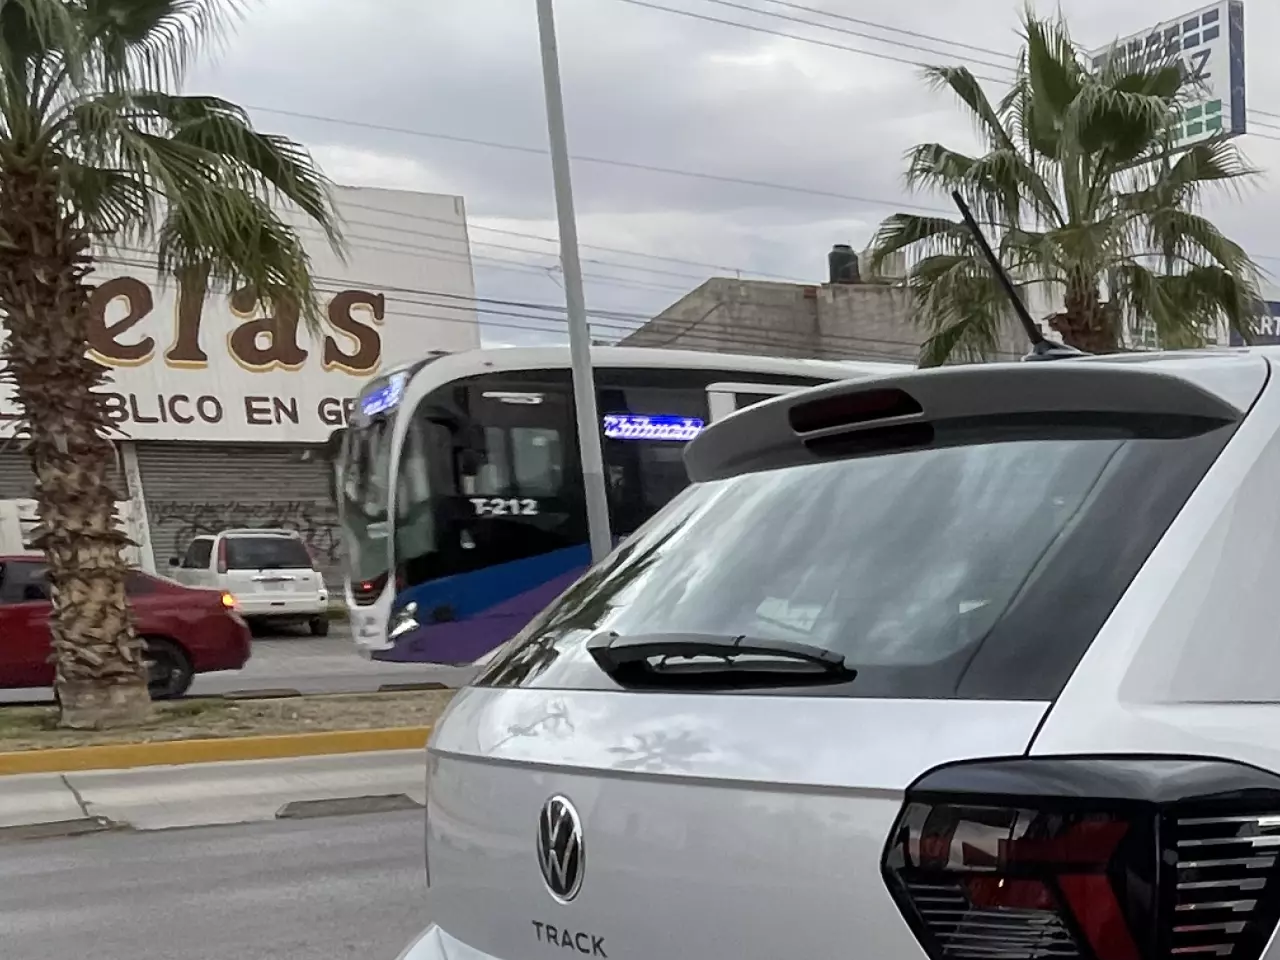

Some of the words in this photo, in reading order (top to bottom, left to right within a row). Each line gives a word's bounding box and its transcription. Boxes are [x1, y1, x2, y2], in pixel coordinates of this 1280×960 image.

[86, 264, 384, 376] elas
[98, 392, 224, 425] BLICO
[244, 396, 299, 425] EN
[531, 919, 609, 959] TRACK
